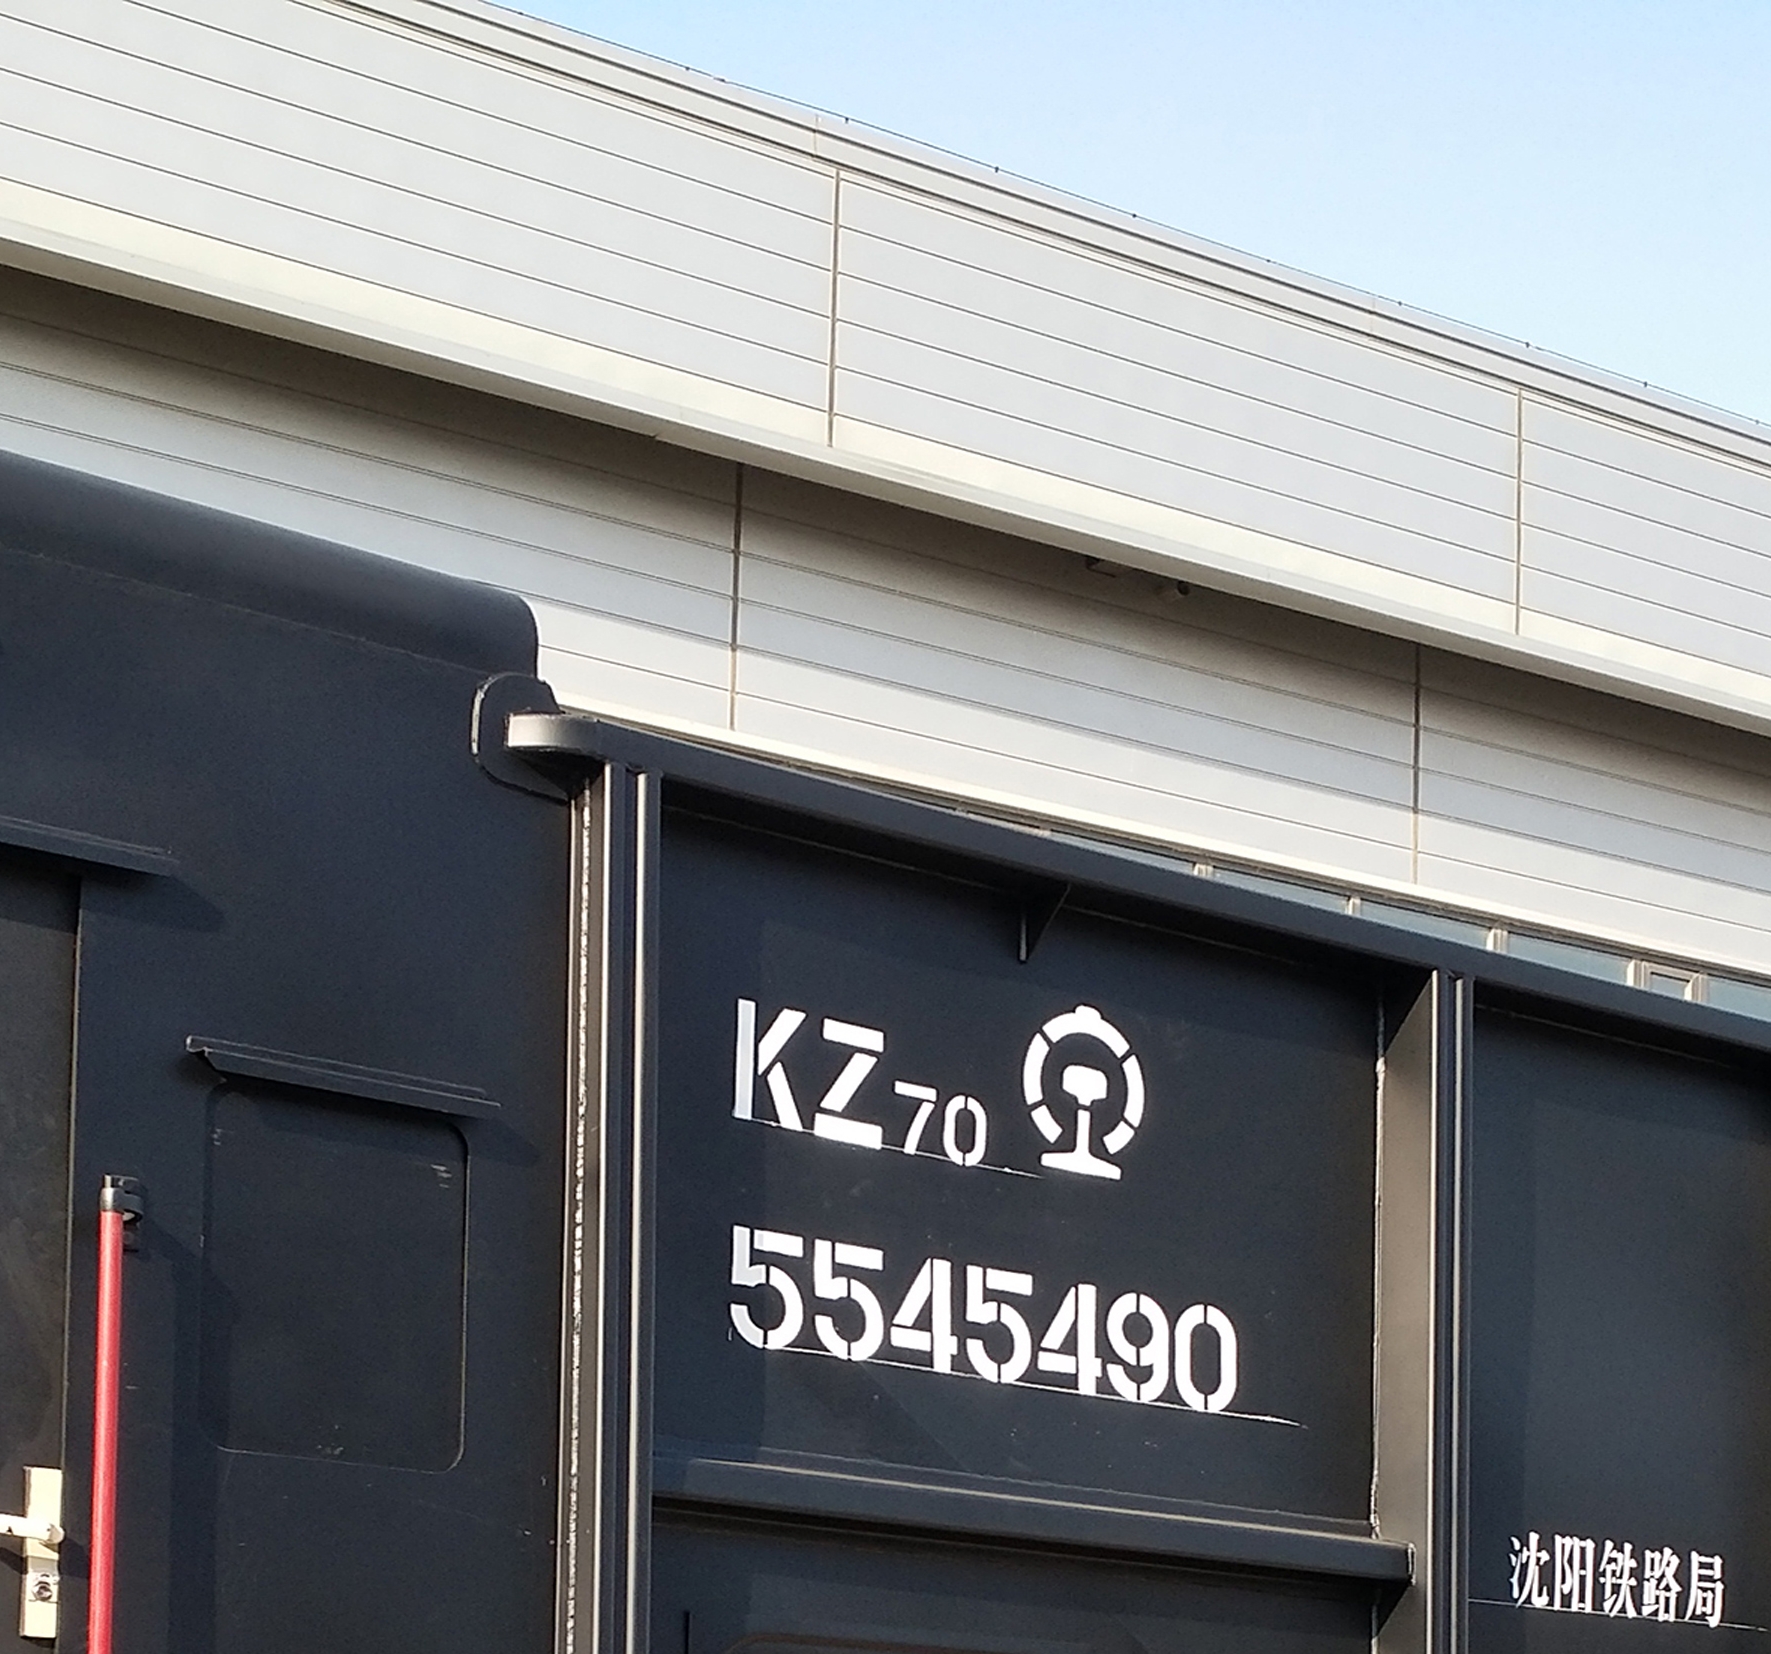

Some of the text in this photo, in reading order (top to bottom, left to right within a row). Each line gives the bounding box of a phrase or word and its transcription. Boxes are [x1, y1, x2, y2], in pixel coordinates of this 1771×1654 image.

[733, 998, 987, 1167] KZ70
[729, 1224, 1237, 1412] 5545490
[1509, 1531, 1725, 1628] 沈阳铁路局
